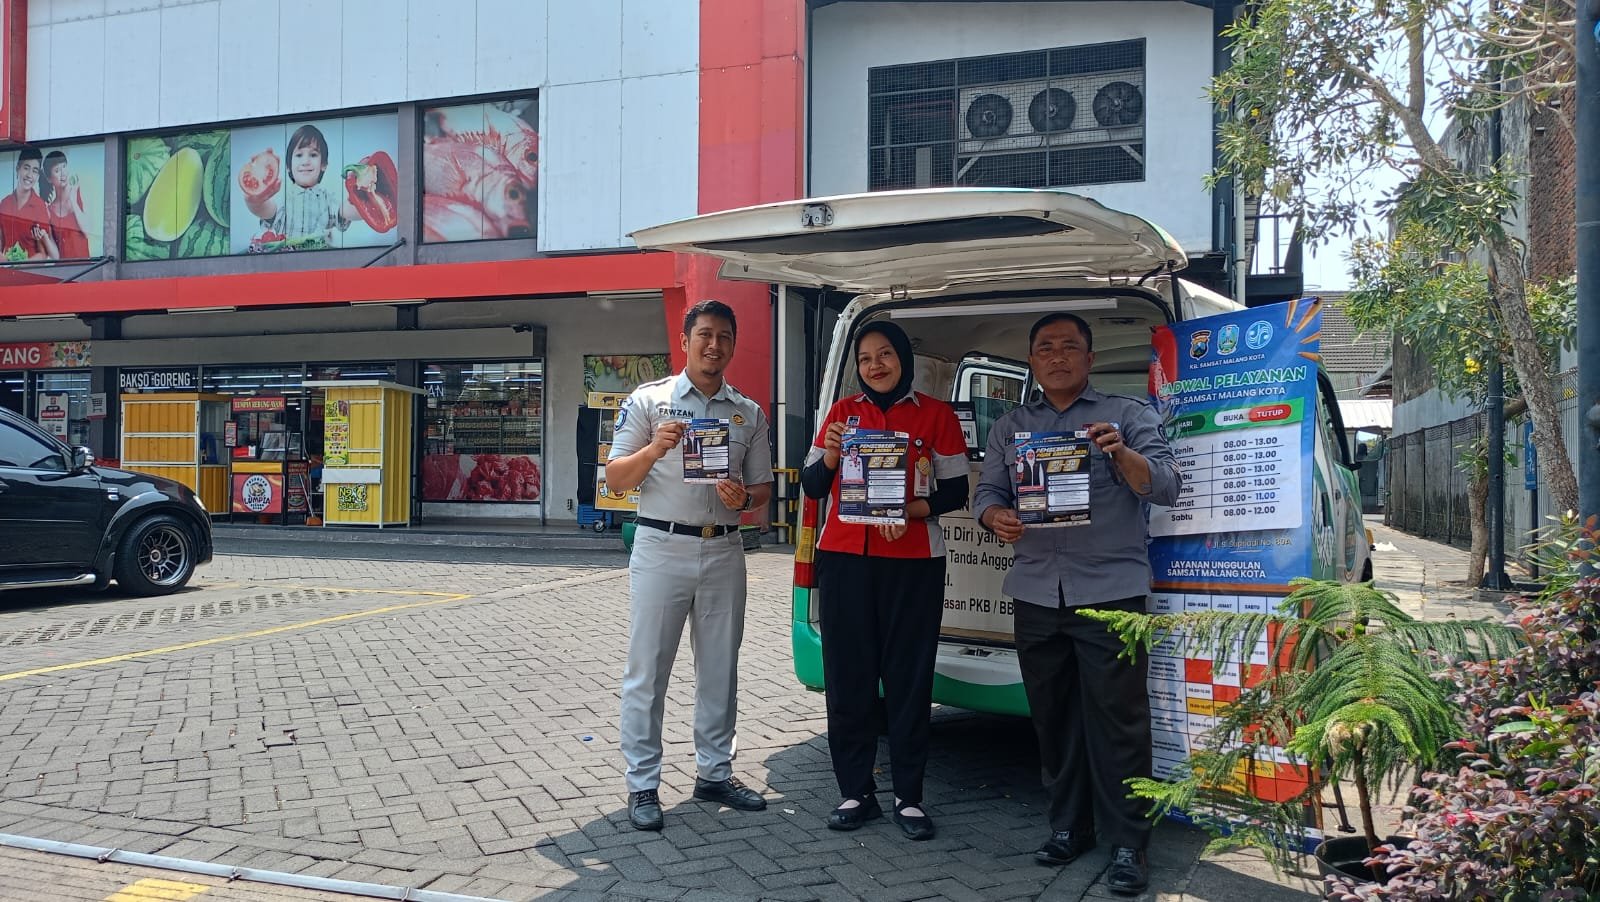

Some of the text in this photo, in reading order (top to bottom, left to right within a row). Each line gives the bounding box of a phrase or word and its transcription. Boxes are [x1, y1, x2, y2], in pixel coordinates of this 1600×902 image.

[1200, 360, 1222, 368] SAMSAT
[1223, 356, 1248, 365] MALANG
[120, 372, 190, 387] BAKSO GORENG
[1159, 366, 1307, 397] JADWAL PELAYANAN
[1184, 393, 1217, 404] SAMSAT
[1218, 388, 1256, 399] MALANG
[1258, 387, 1286, 396] KOTA
[660, 408, 694, 418] FAWZAN
[1256, 409, 1283, 417] TUTUP
[1224, 440, 1246, 448] 08.00
[1255, 437, 1277, 445] 13.00
[1174, 446, 1194, 455] Senin
[1224, 453, 1246, 462] 08.00
[1255, 451, 1276, 459] 13.00
[1224, 467, 1246, 475] 08.00
[1254, 464, 1276, 472] 13.00
[1224, 480, 1246, 488] 08.00
[1254, 478, 1276, 486] 13.00
[1224, 494, 1246, 502] 08.00
[1256, 492, 1276, 500] 11.00
[1224, 508, 1246, 516] 08.00
[1254, 506, 1275, 514] 12.00
[954, 526, 974, 542] Diri
[949, 549, 1015, 570] Tanda Anggo
[1211, 562, 1260, 570] UNGGULAN
[1240, 570, 1266, 578] KOTA
[944, 598, 966, 610] asan
[970, 598, 990, 612] PKB
[1000, 601, 1014, 615] BB
